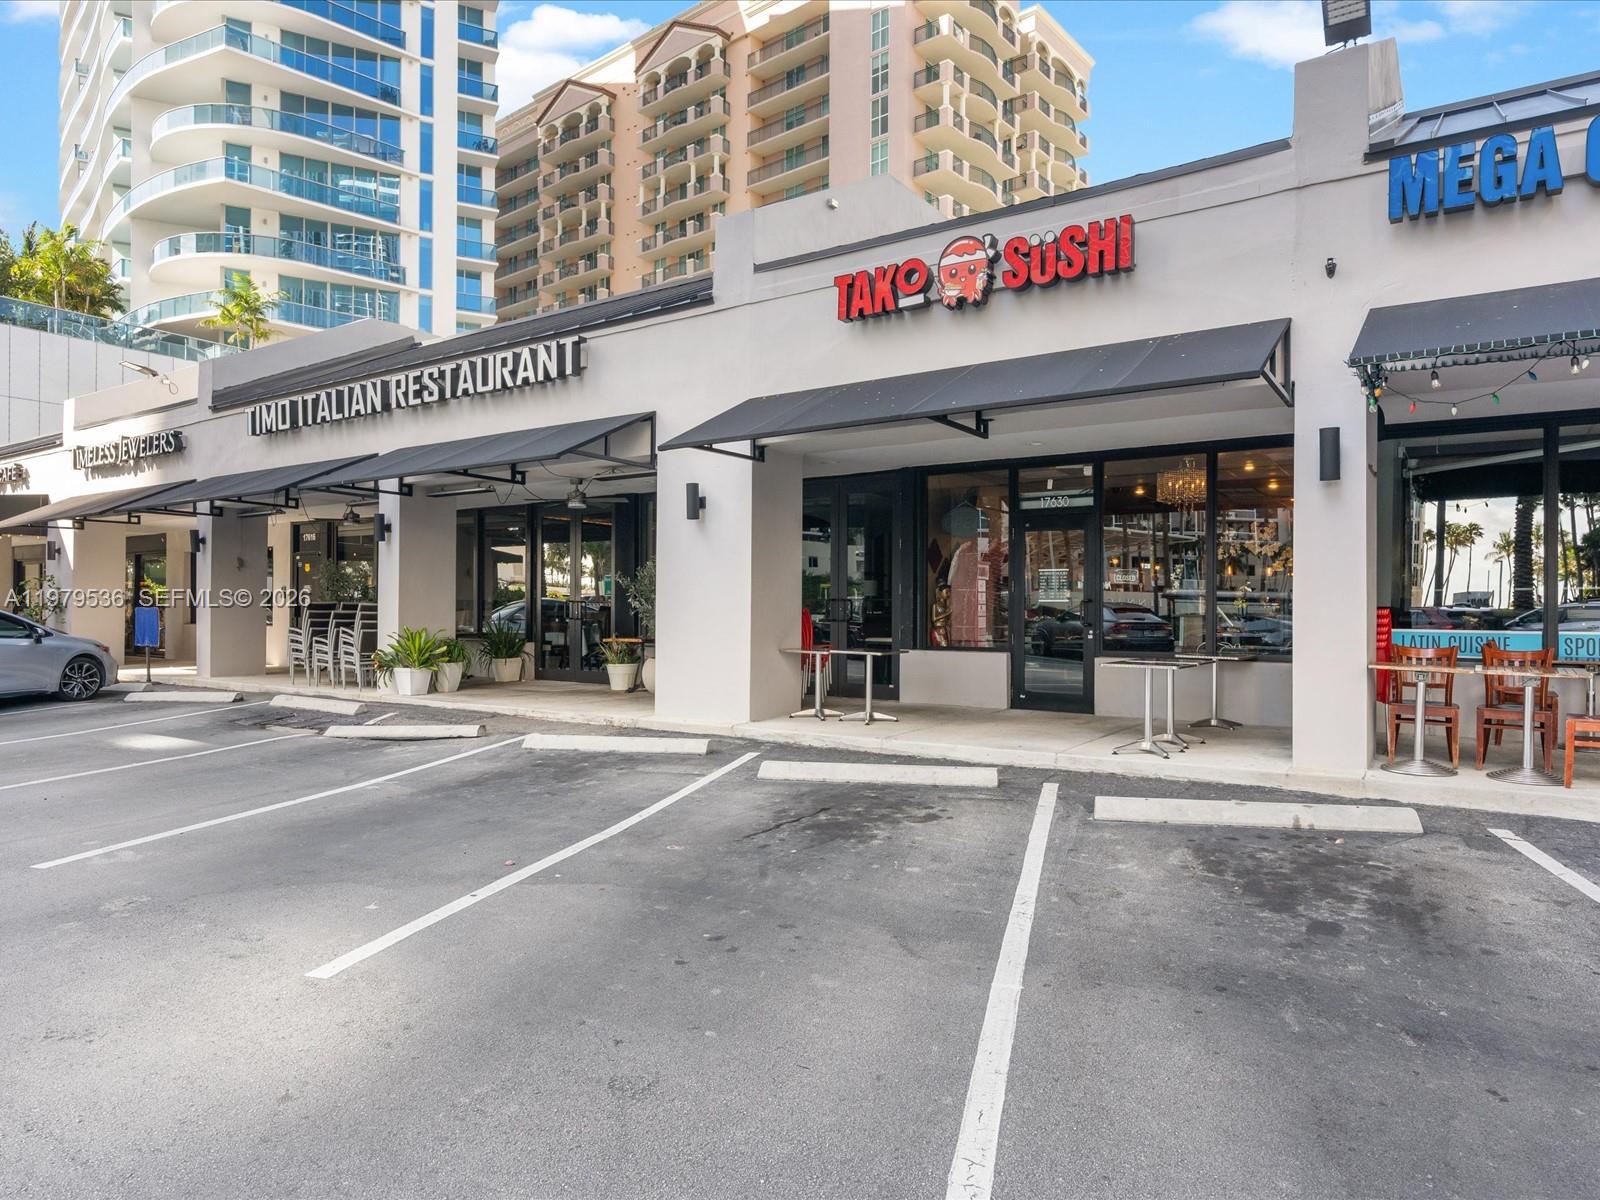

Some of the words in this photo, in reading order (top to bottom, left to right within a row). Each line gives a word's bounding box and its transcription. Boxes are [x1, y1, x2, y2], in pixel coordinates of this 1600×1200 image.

[1389, 125, 1564, 222] MEGA
[834, 258, 929, 321] TAKO
[245, 400, 291, 436] TIMO
[297, 379, 382, 427] ITALIAN
[390, 336, 582, 409] RESTAURANT
[117, 431, 176, 464] JEWELERS
[1040, 496, 1069, 508] 17630
[1564, 637, 1600, 656] SPO
